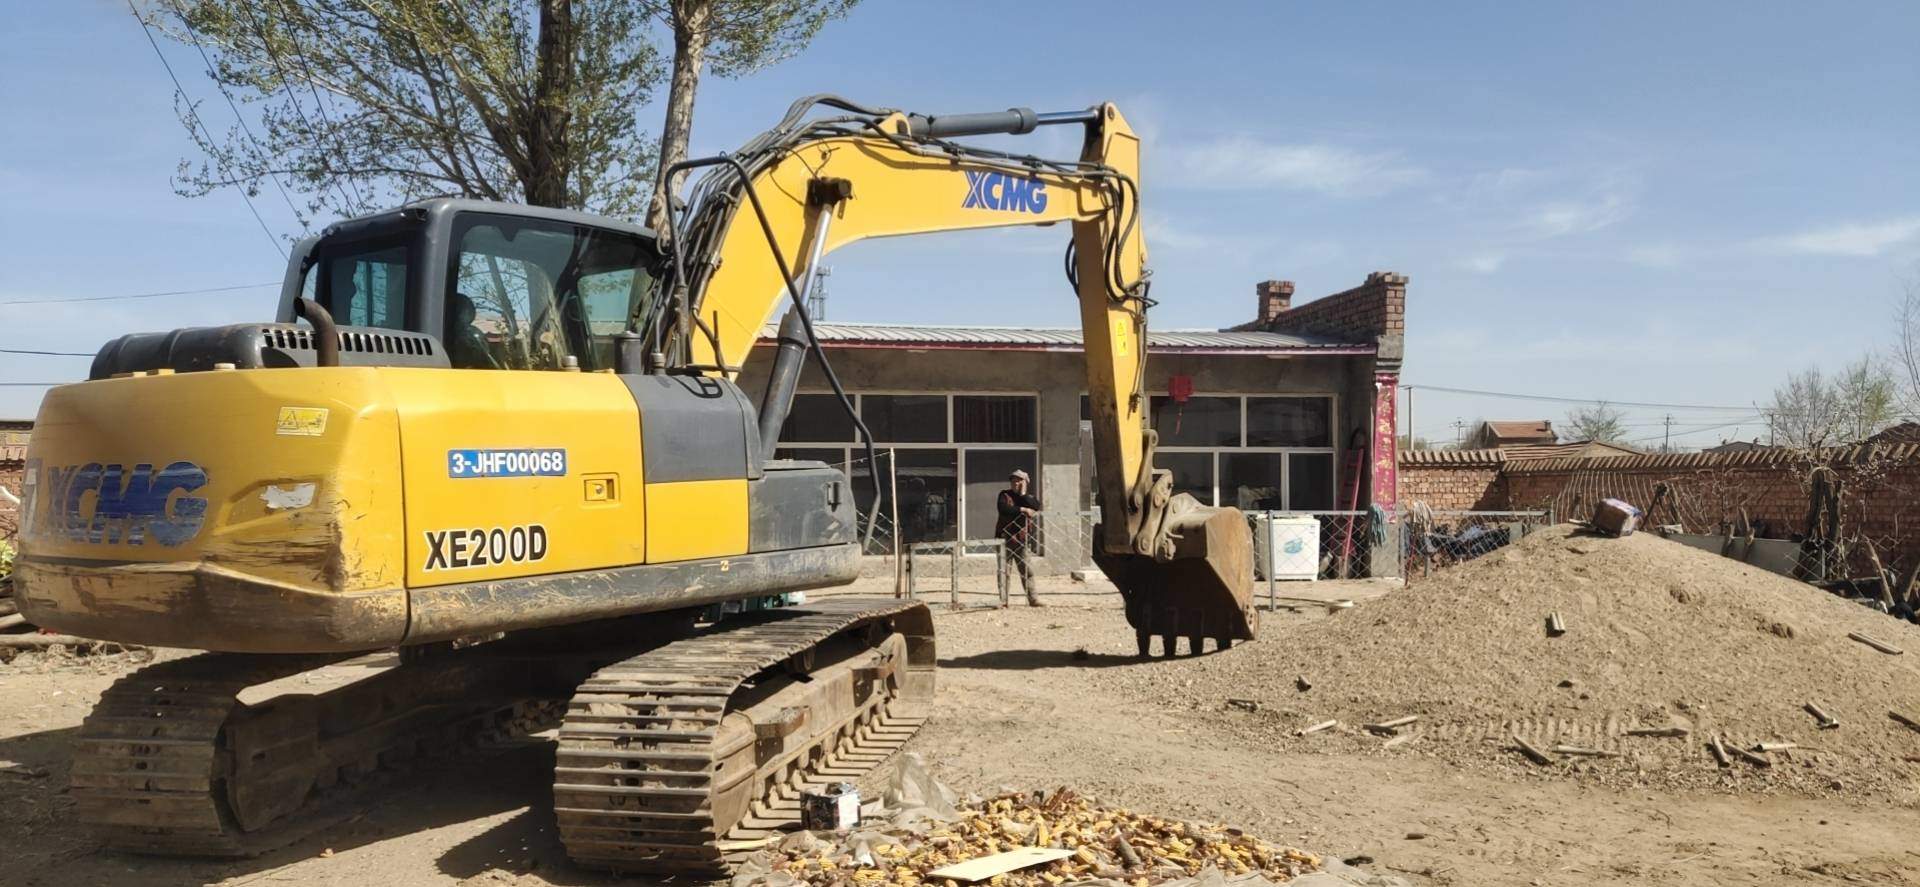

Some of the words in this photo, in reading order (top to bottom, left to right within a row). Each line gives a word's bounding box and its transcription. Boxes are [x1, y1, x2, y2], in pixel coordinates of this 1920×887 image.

[962, 170, 1048, 214] XCMG
[452, 452, 564, 474] 3-JHF00068
[424, 524, 548, 571] XE200D
